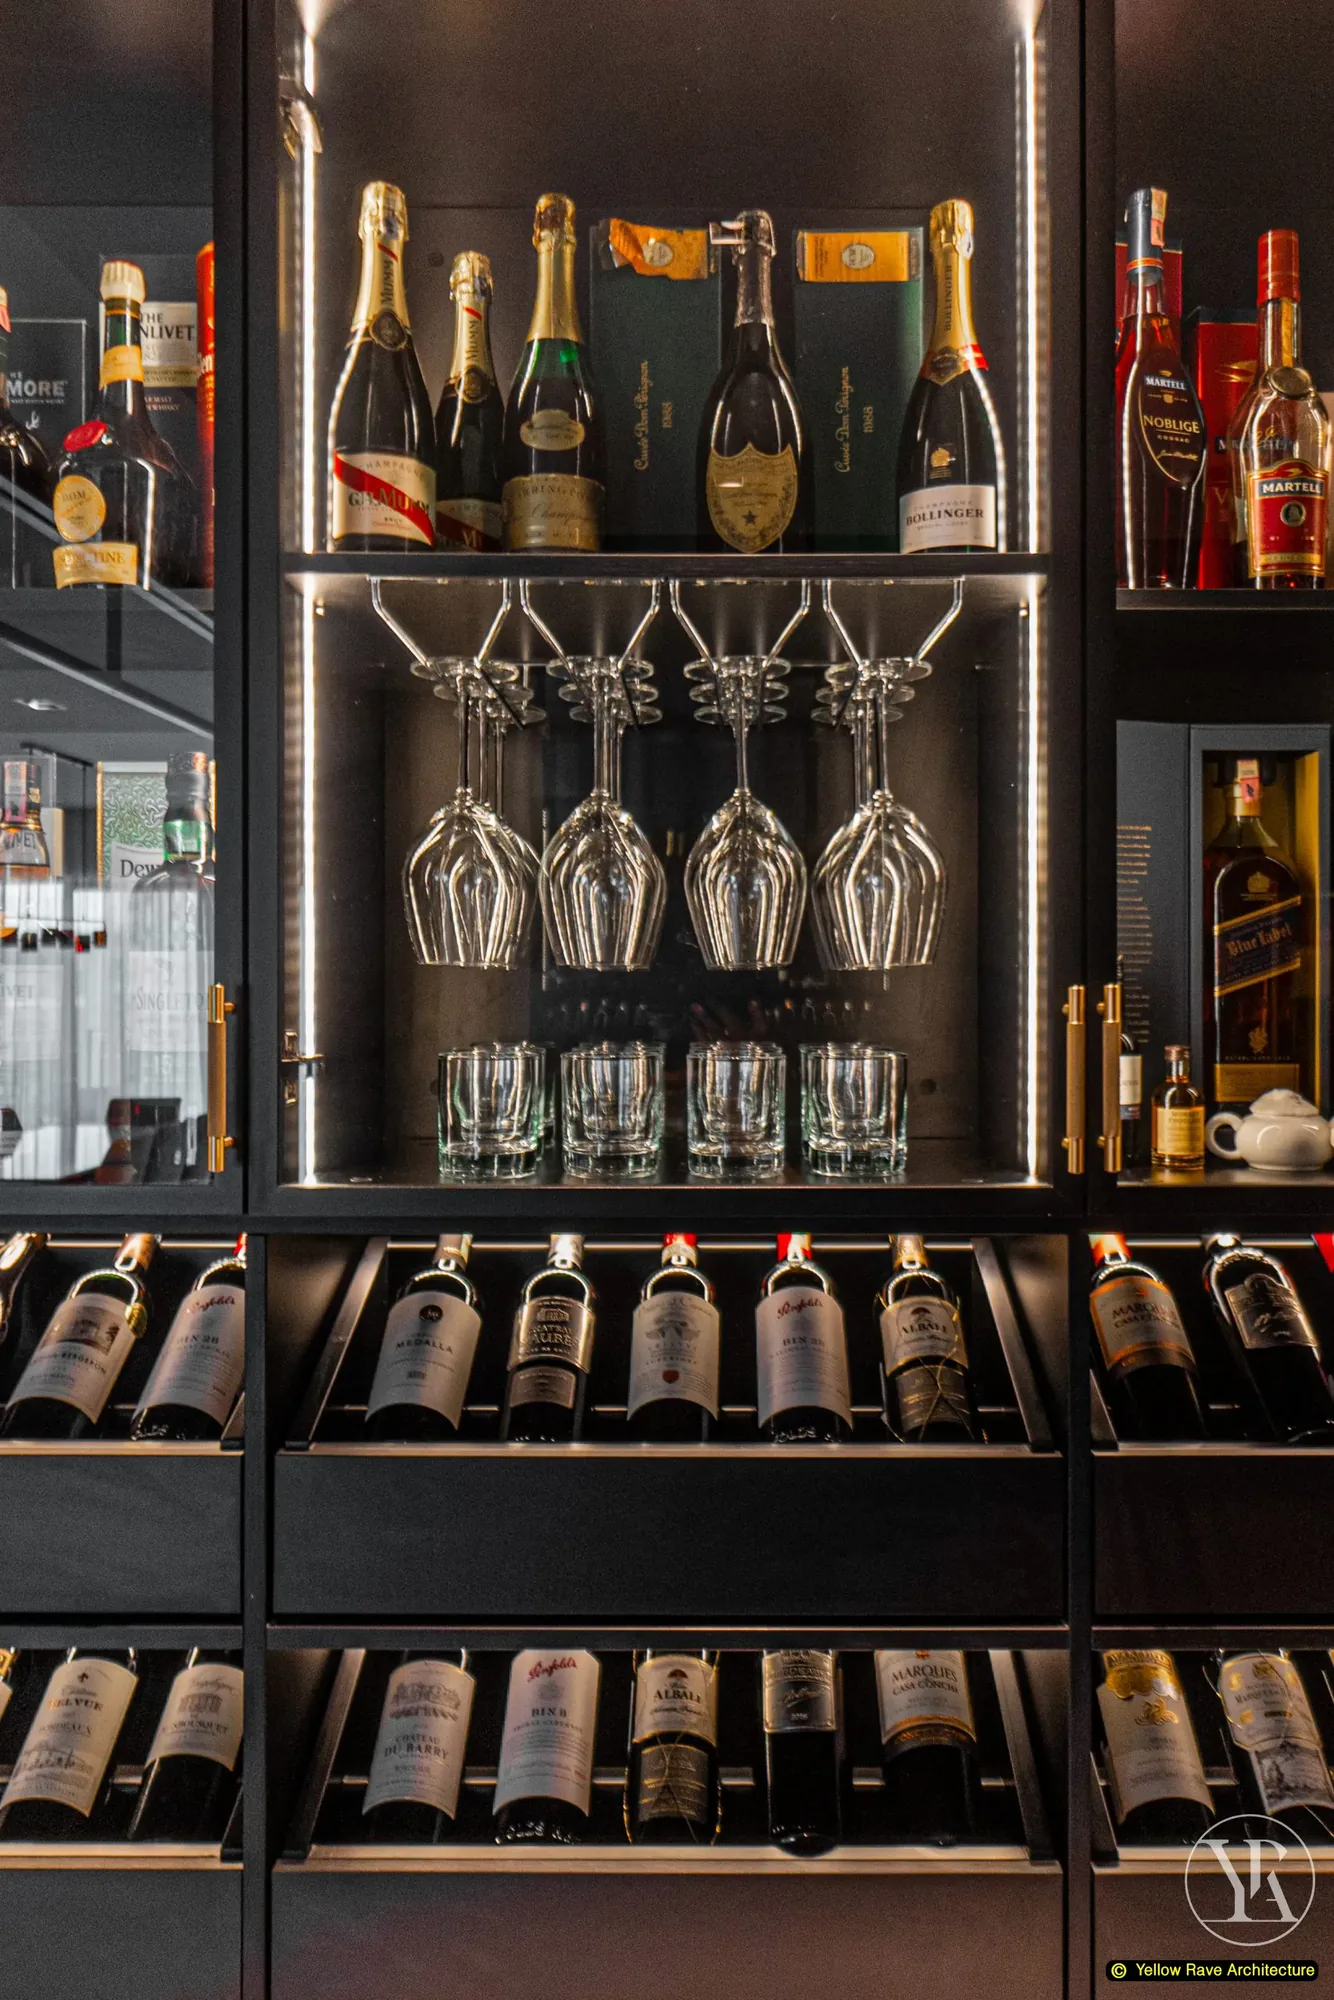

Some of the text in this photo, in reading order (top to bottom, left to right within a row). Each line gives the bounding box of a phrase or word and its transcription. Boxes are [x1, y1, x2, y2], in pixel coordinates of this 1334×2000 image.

[140, 325, 194, 341] NLIVET
[7, 380, 65, 397] MORE
[1146, 377, 1186, 391] MARTELL
[1143, 414, 1200, 434] NOBLIGE
[1262, 482, 1320, 494] MARTELL
[905, 508, 984, 526] BOLLINGER
[120, 859, 158, 878] Dew
[1226, 938, 1258, 957] Blue
[1257, 921, 1293, 946] Label
[136, 988, 208, 1011] SINGLETO
[891, 1664, 958, 1684] MARQUES
[653, 1688, 702, 1704] ALBALI
[531, 1707, 556, 1717] BIN
[406, 1742, 449, 1760] BARRY
